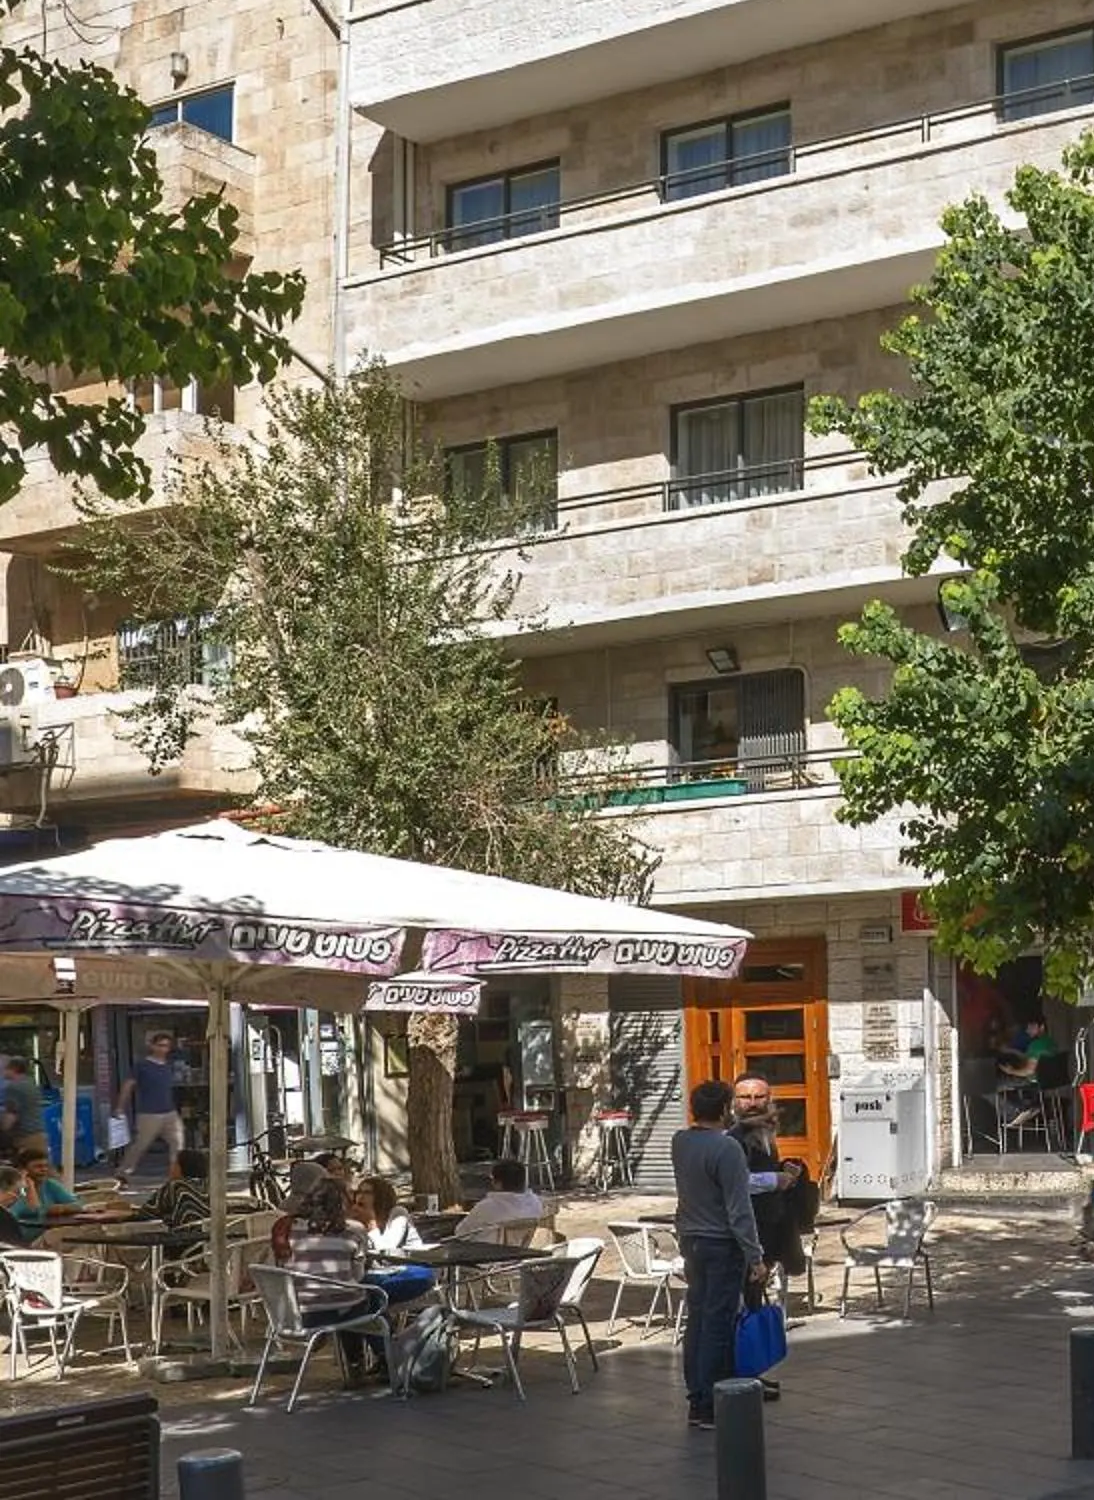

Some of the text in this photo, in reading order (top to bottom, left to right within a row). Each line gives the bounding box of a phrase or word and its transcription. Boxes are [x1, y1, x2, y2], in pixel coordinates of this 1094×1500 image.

[70, 908, 222, 946] Pizza Hut
[230, 922, 392, 962] פשוט טעים
[495, 934, 609, 962] Pizza Hut
[614, 938, 735, 968] פשוט טעים
[385, 985, 429, 1005] טעים
[429, 988, 474, 1006] פשוט
[855, 1099, 882, 1113] push
